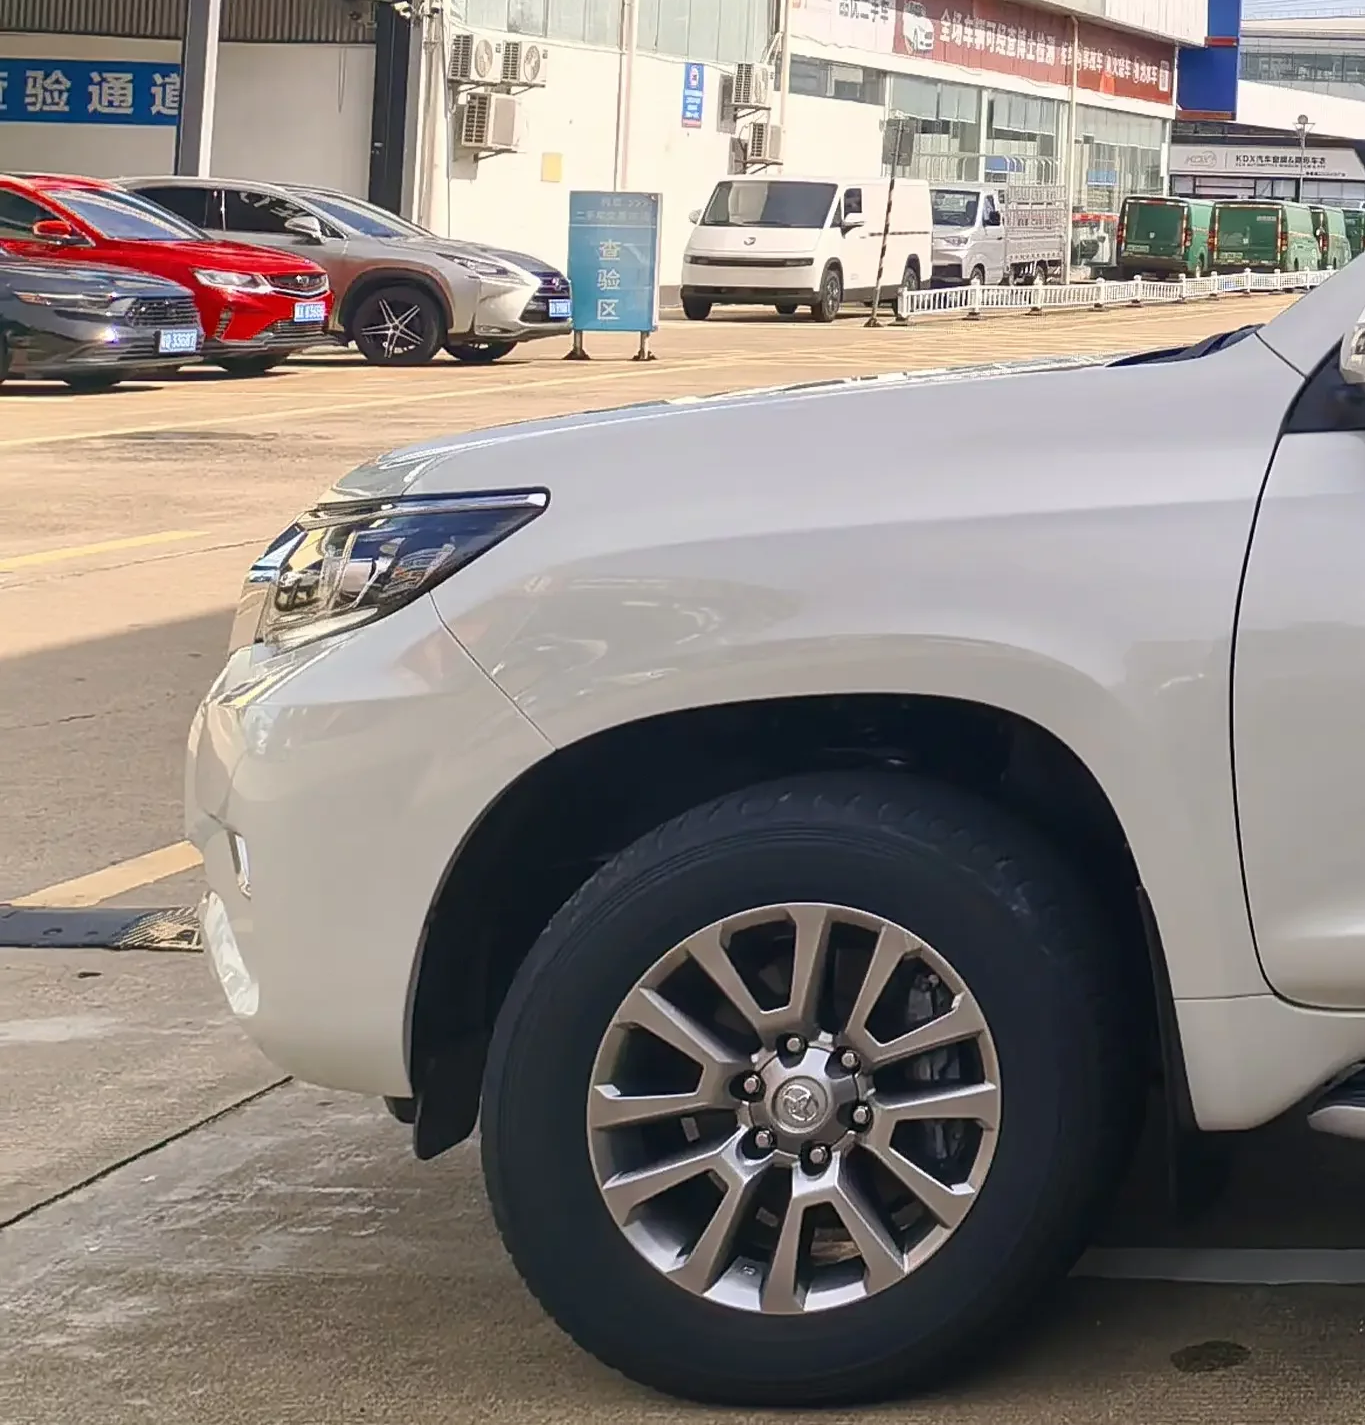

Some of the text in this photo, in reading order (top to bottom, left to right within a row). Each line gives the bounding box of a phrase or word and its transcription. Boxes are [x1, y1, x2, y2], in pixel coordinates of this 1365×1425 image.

[0, 68, 181, 116] 验通道
[597, 239, 622, 320] 查验区
